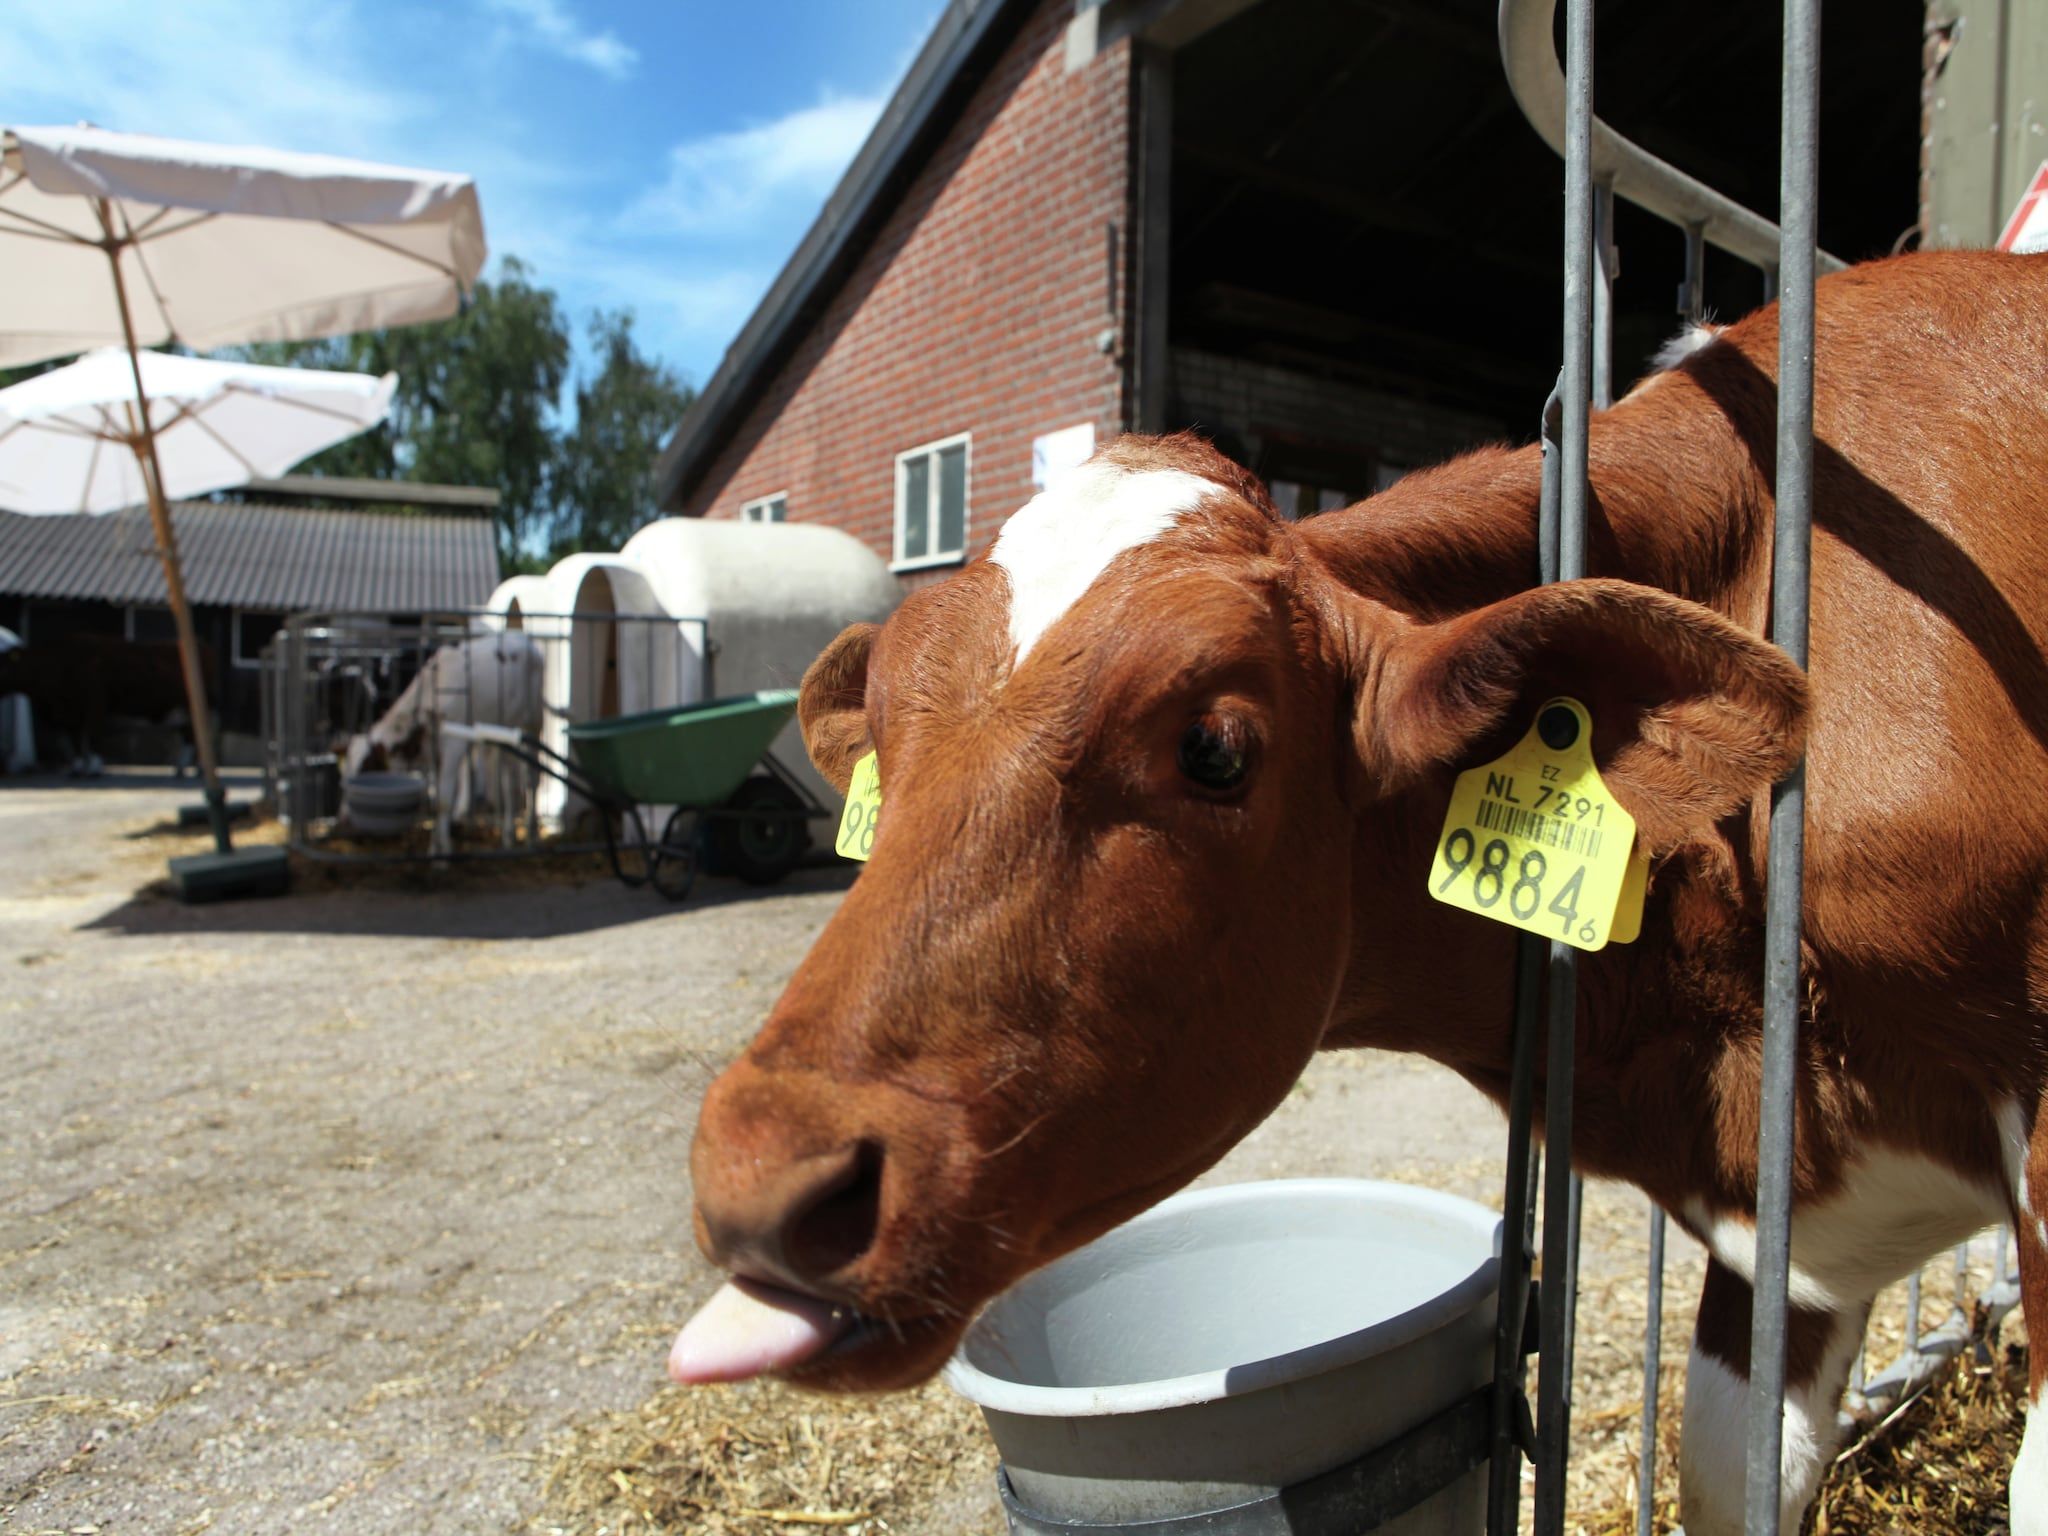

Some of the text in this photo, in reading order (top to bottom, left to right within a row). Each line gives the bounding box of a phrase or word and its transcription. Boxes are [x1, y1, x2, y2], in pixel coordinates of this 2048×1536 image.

[1541, 765, 1561, 782] EZ
[1486, 771, 1604, 827] NL 7291
